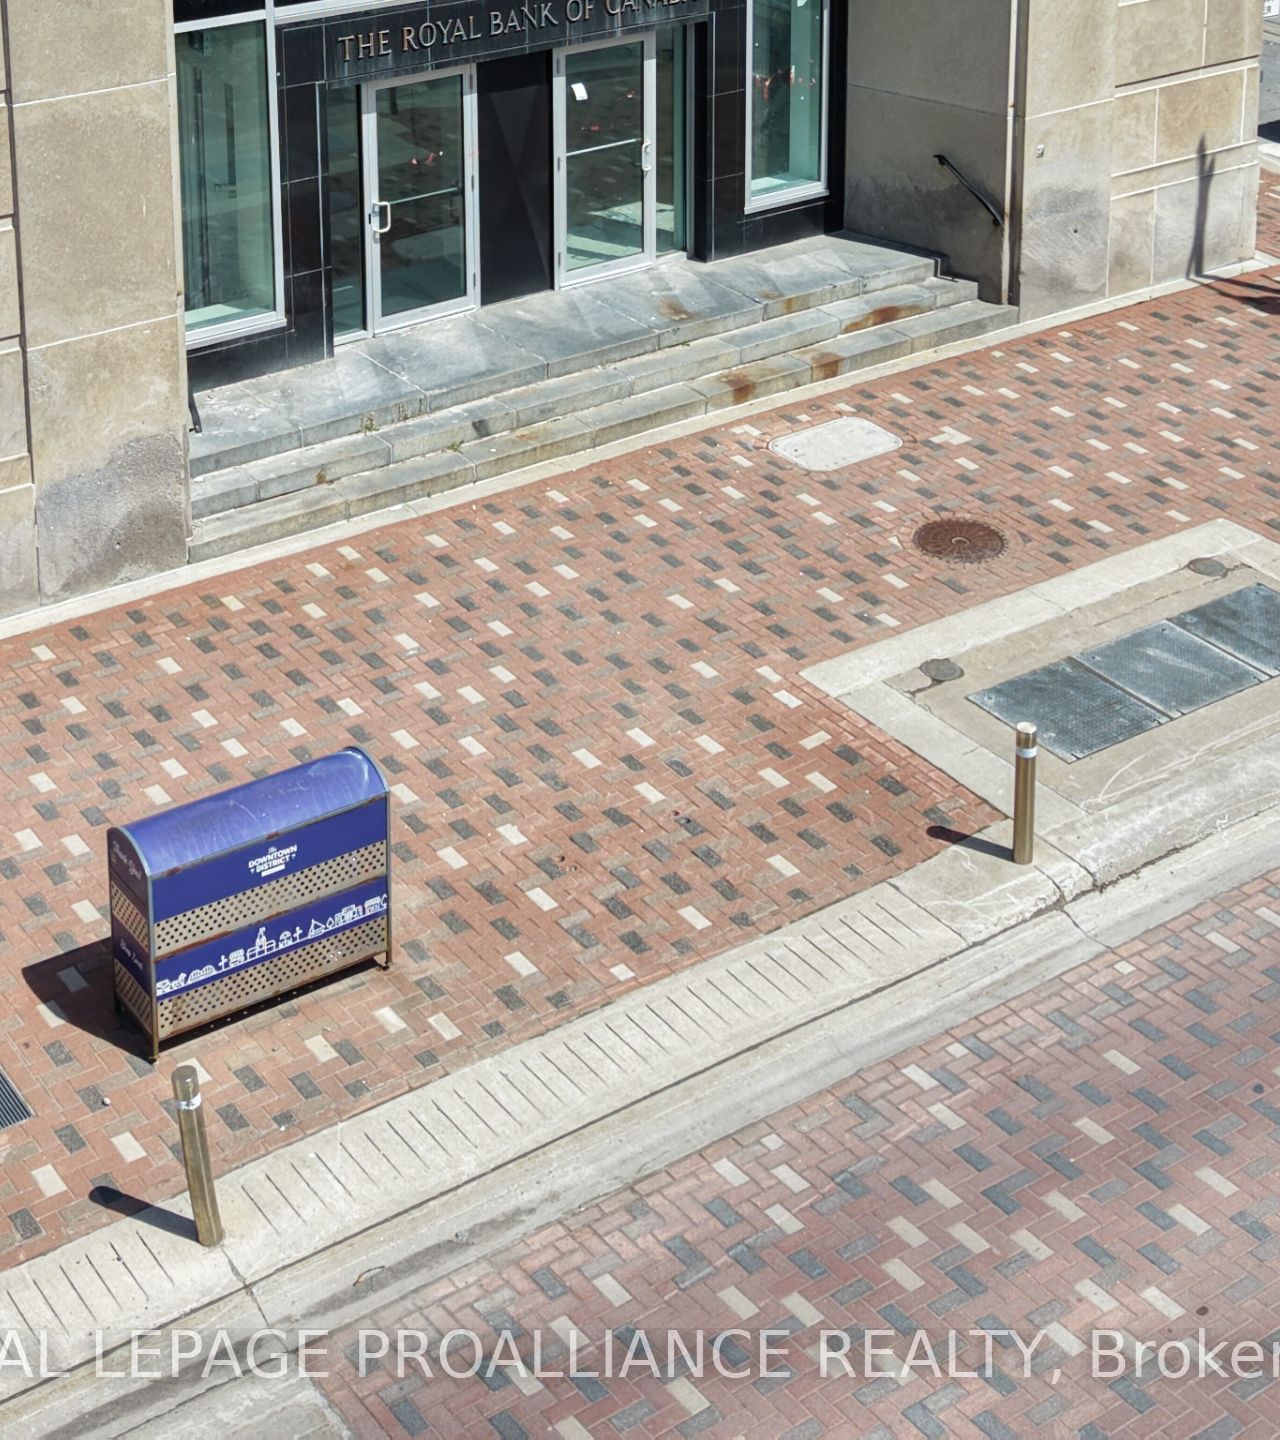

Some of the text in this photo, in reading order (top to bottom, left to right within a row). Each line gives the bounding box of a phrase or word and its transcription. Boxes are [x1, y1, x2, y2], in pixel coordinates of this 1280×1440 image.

[337, 29, 392, 63] THE
[402, 15, 482, 53] ROYAL
[489, 1, 560, 38] BANK
[248, 844, 298, 869] DOWNTOWN
[256, 855, 290, 873] DISTRICT
